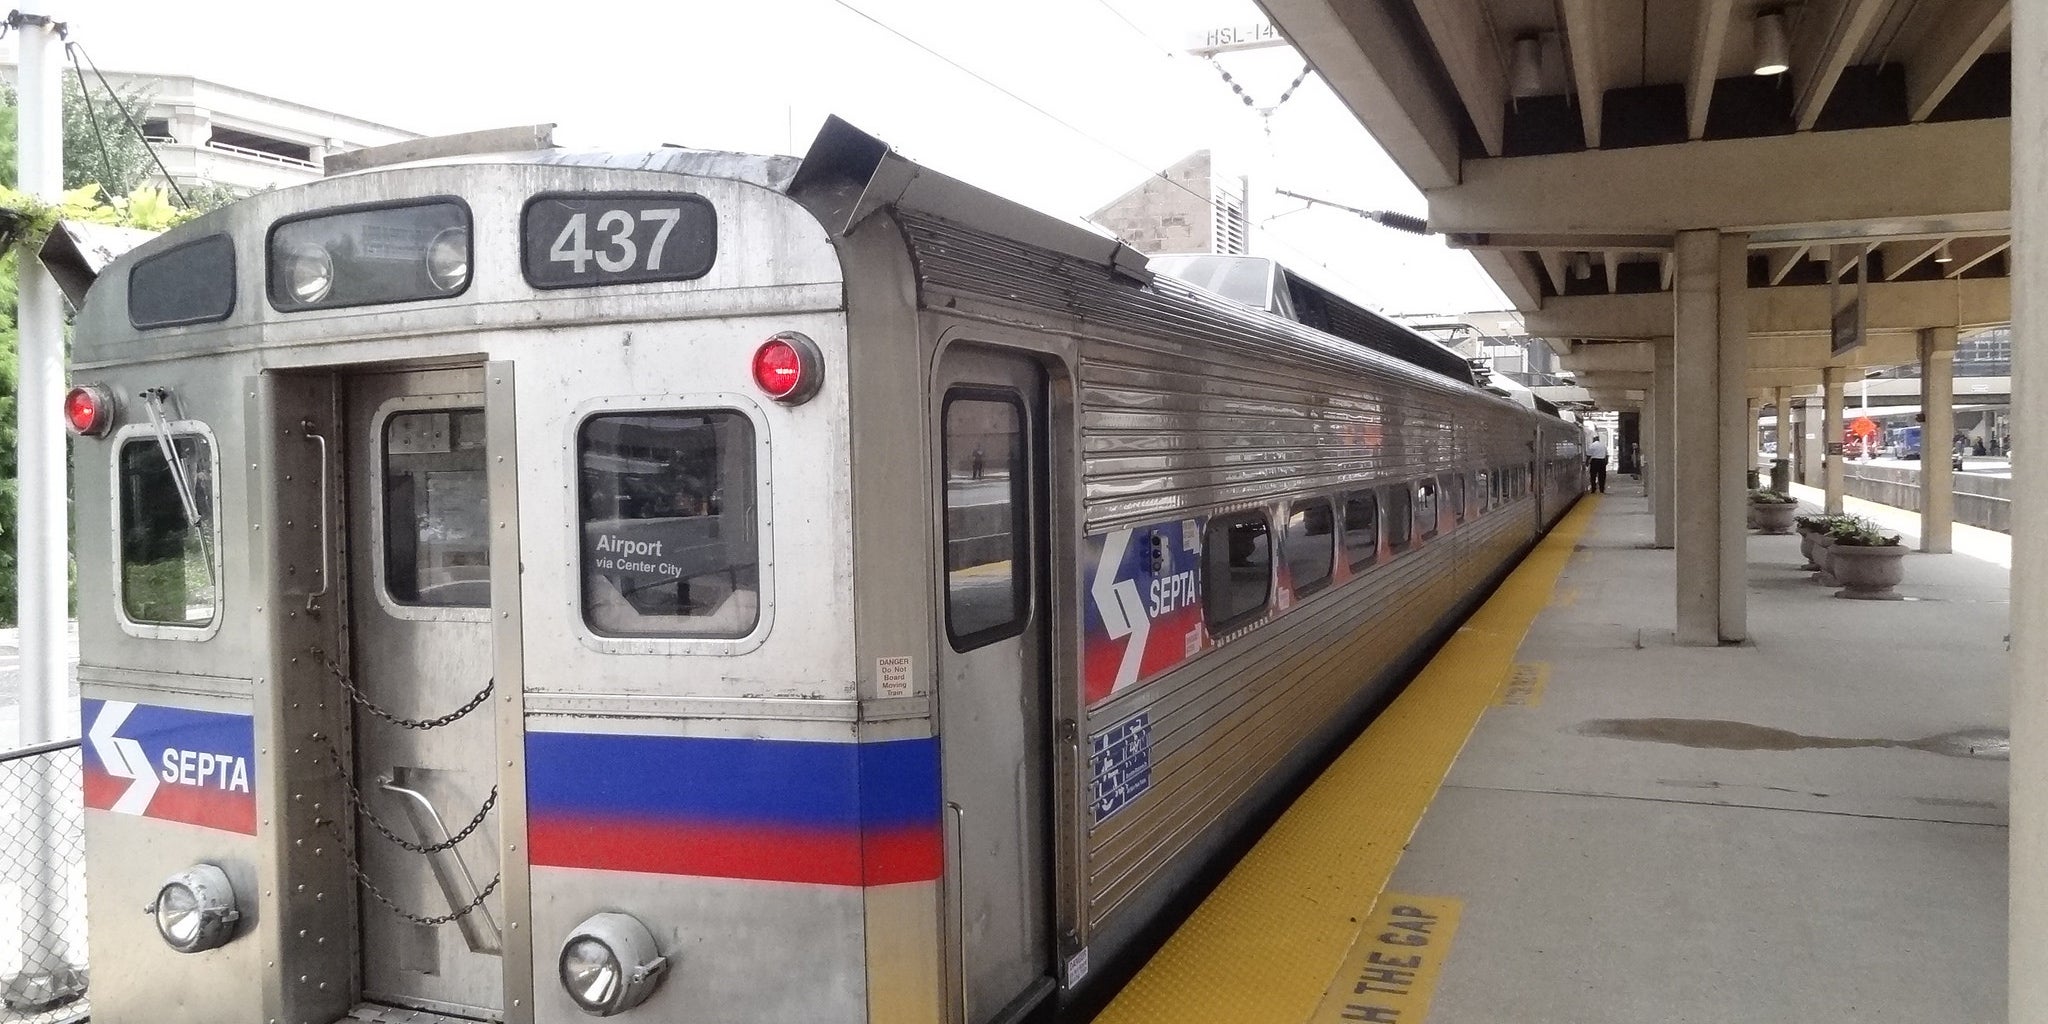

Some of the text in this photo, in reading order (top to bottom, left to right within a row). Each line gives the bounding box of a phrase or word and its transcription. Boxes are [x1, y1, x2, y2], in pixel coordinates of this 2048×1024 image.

[550, 208, 680, 273] 437
[596, 534, 662, 557] Airport
[596, 557, 682, 578] via Center City
[1149, 570, 1196, 618] SEPTA
[880, 658, 909, 666] DANGER
[162, 748, 249, 793] SEPTA
[1377, 905, 1438, 947] GAP
[1354, 952, 1421, 995] THE
